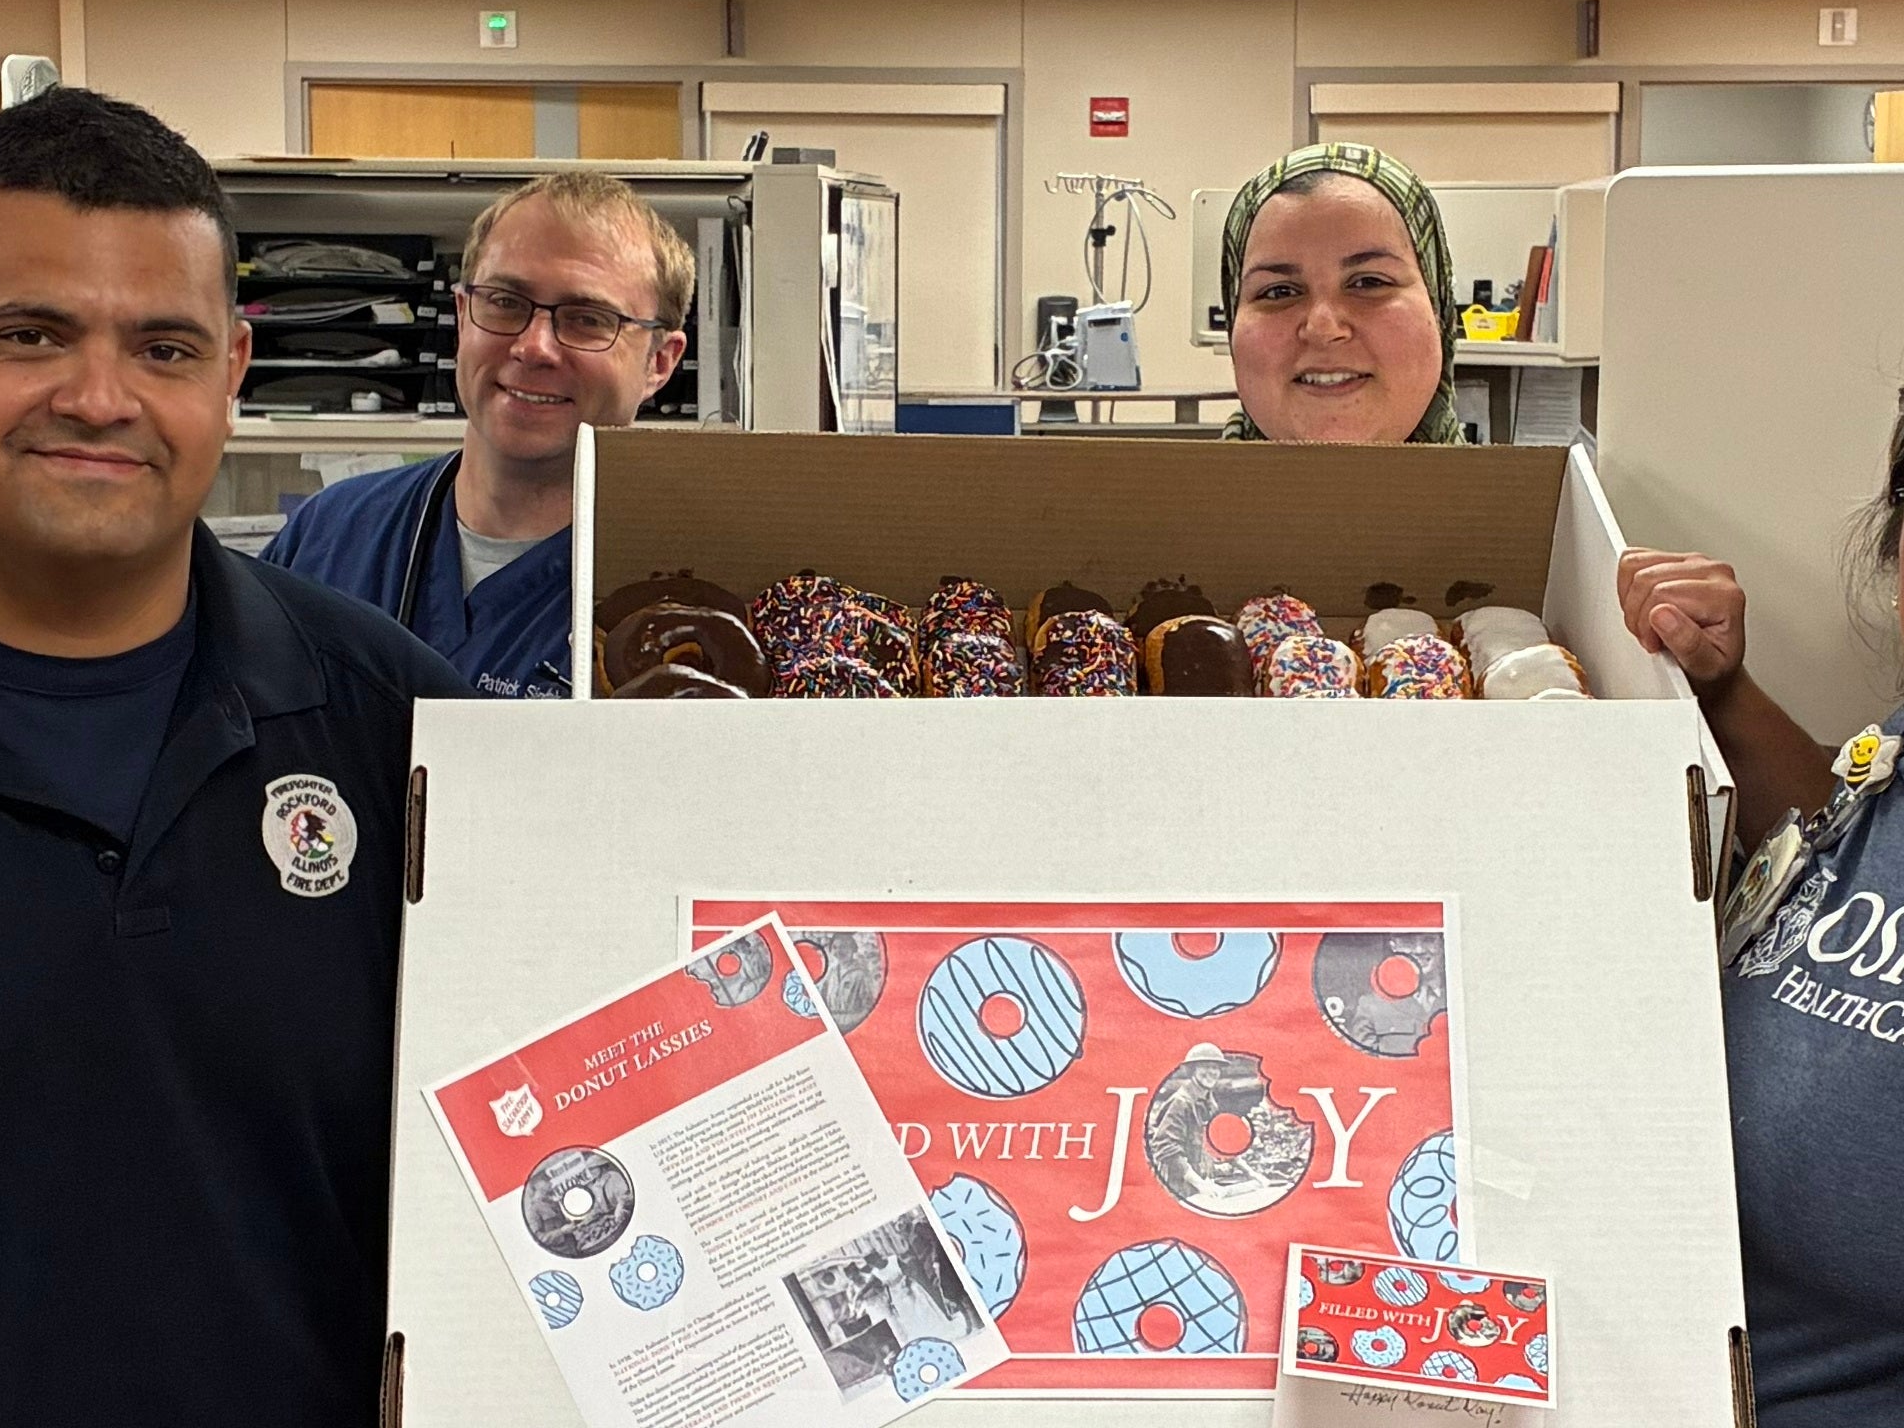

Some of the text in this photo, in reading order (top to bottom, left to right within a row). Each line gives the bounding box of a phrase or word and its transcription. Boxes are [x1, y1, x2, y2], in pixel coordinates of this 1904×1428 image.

[270, 779, 334, 799] FIREFIGHTER
[276, 793, 338, 821] ROCKFORD
[291, 853, 339, 874] ILLINOIS
[286, 871, 313, 892] FIRE
[583, 1020, 665, 1073] MEET THE
[553, 1019, 714, 1112] DONUT LASSIES
[946, 1122, 1097, 1161] WITH
[1318, 1301, 1380, 1321] FILLED
[1382, 1310, 1432, 1328] WITH
[1340, 1383, 1400, 1412] Happy
